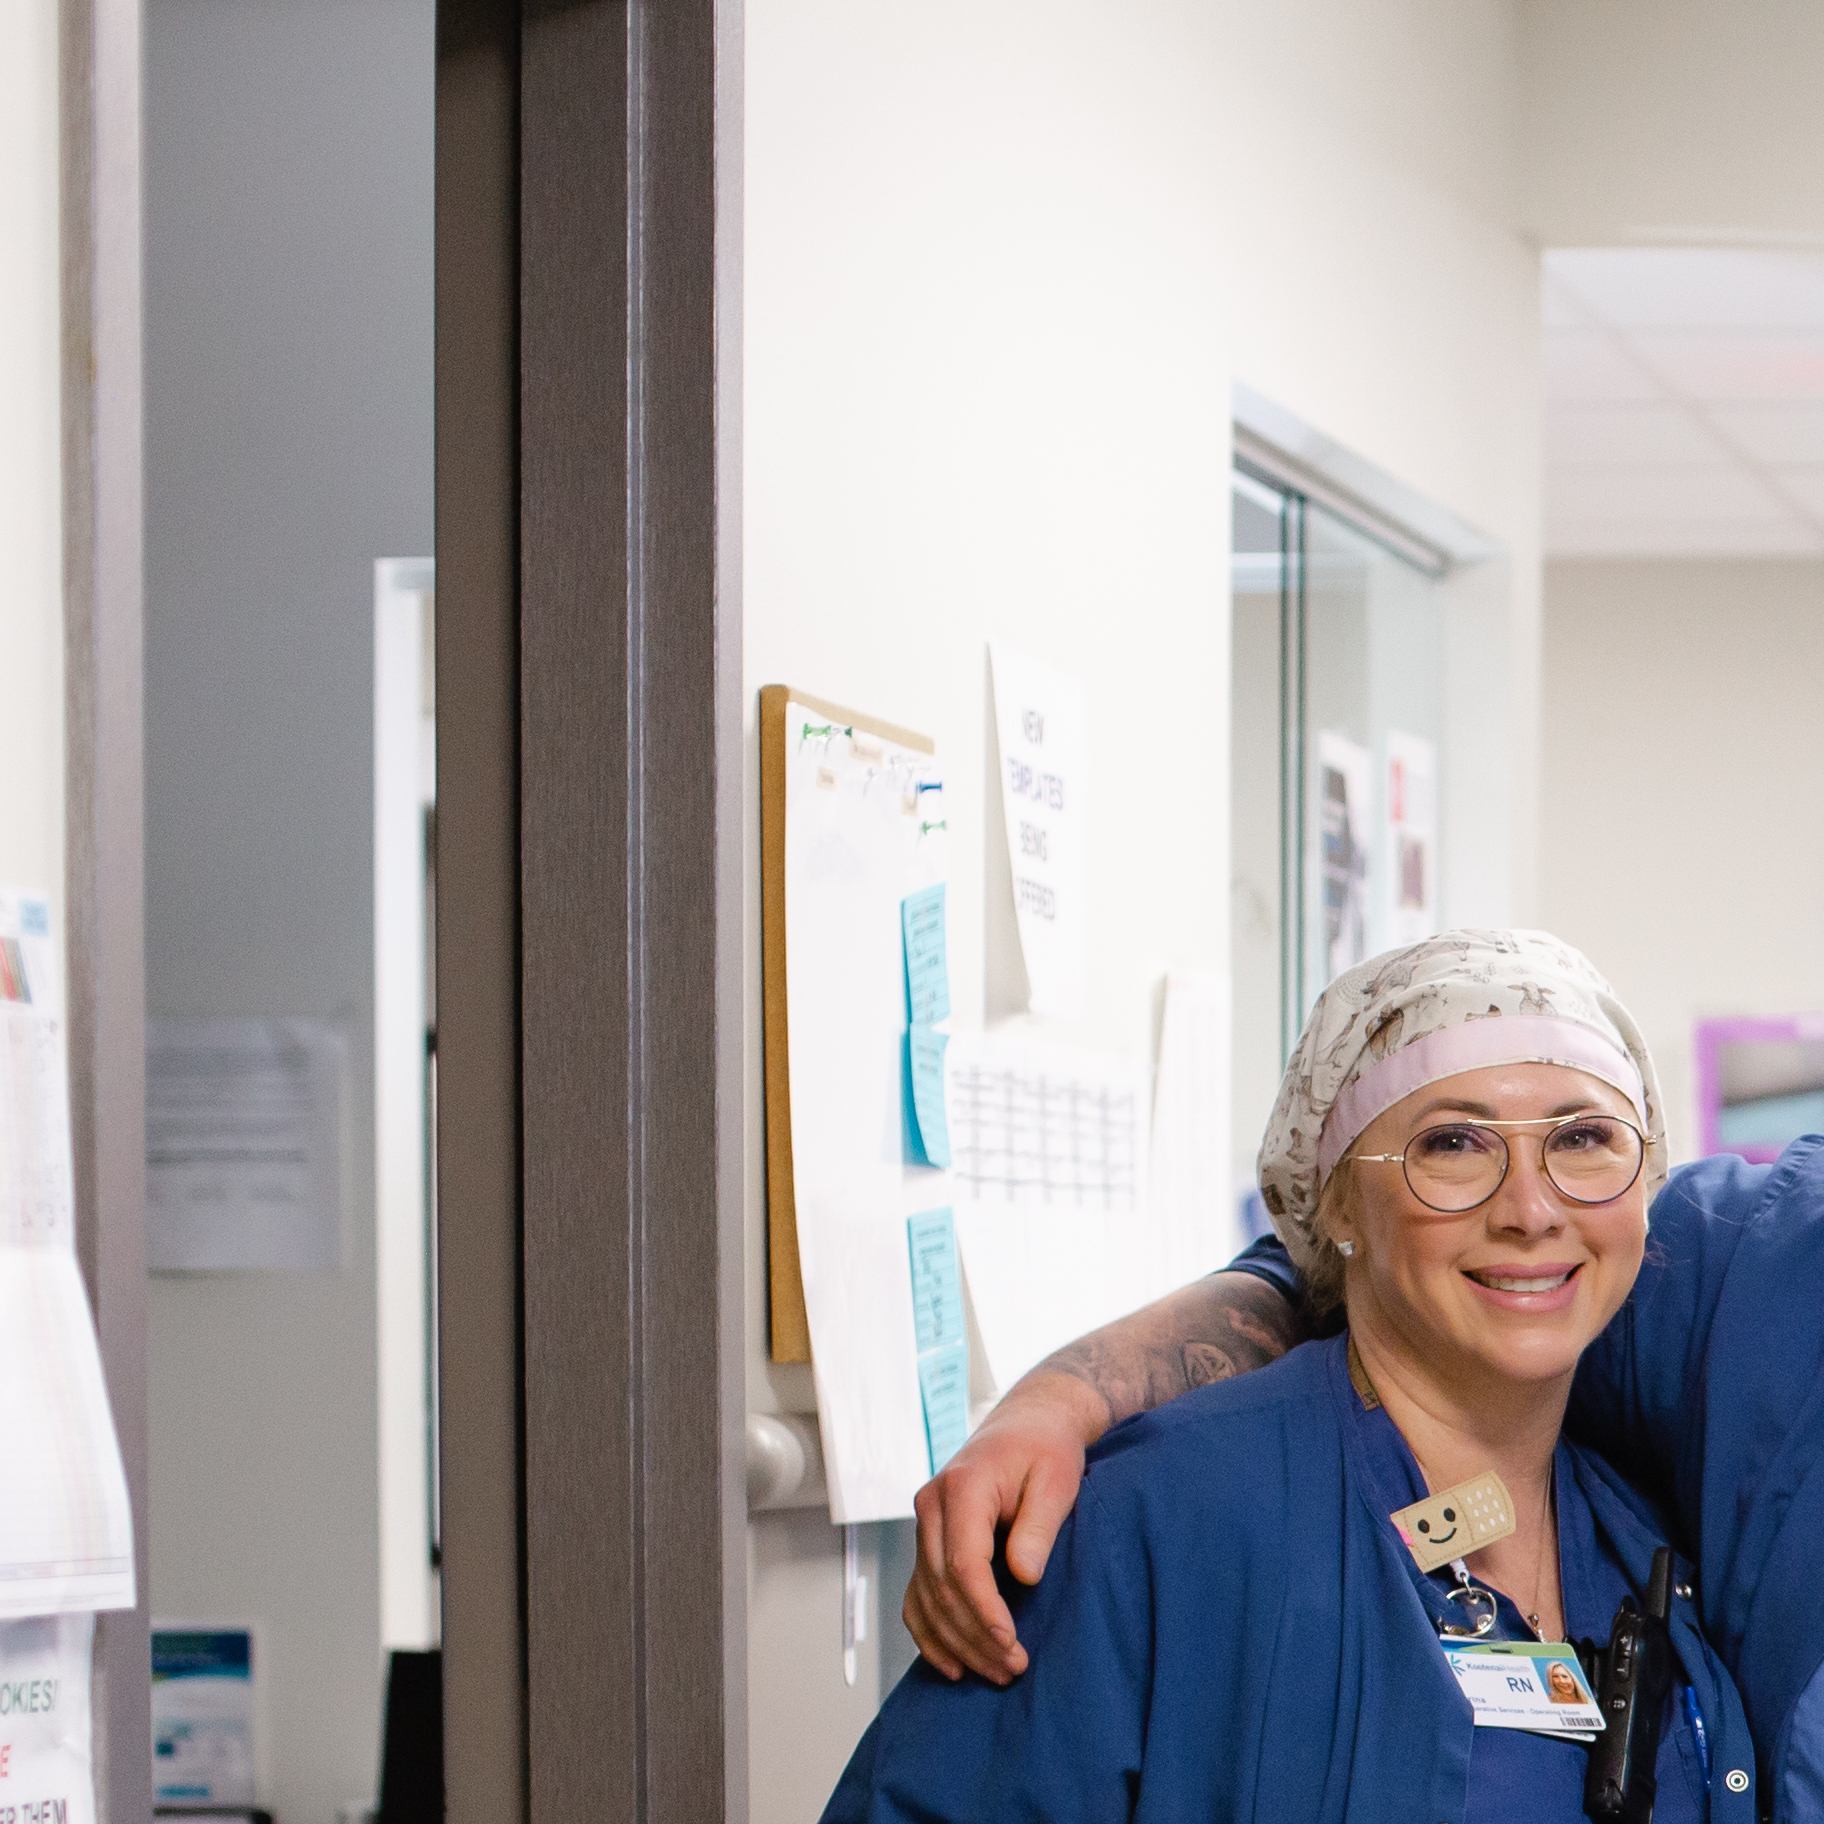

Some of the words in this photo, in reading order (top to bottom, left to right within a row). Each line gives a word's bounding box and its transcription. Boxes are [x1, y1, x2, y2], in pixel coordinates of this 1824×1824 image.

[1506, 1676, 1535, 1694] RN
[1500, 1706, 1525, 1715] Services
[1530, 1707, 1562, 1717] Operating
[1562, 1708, 1582, 1716] Room
